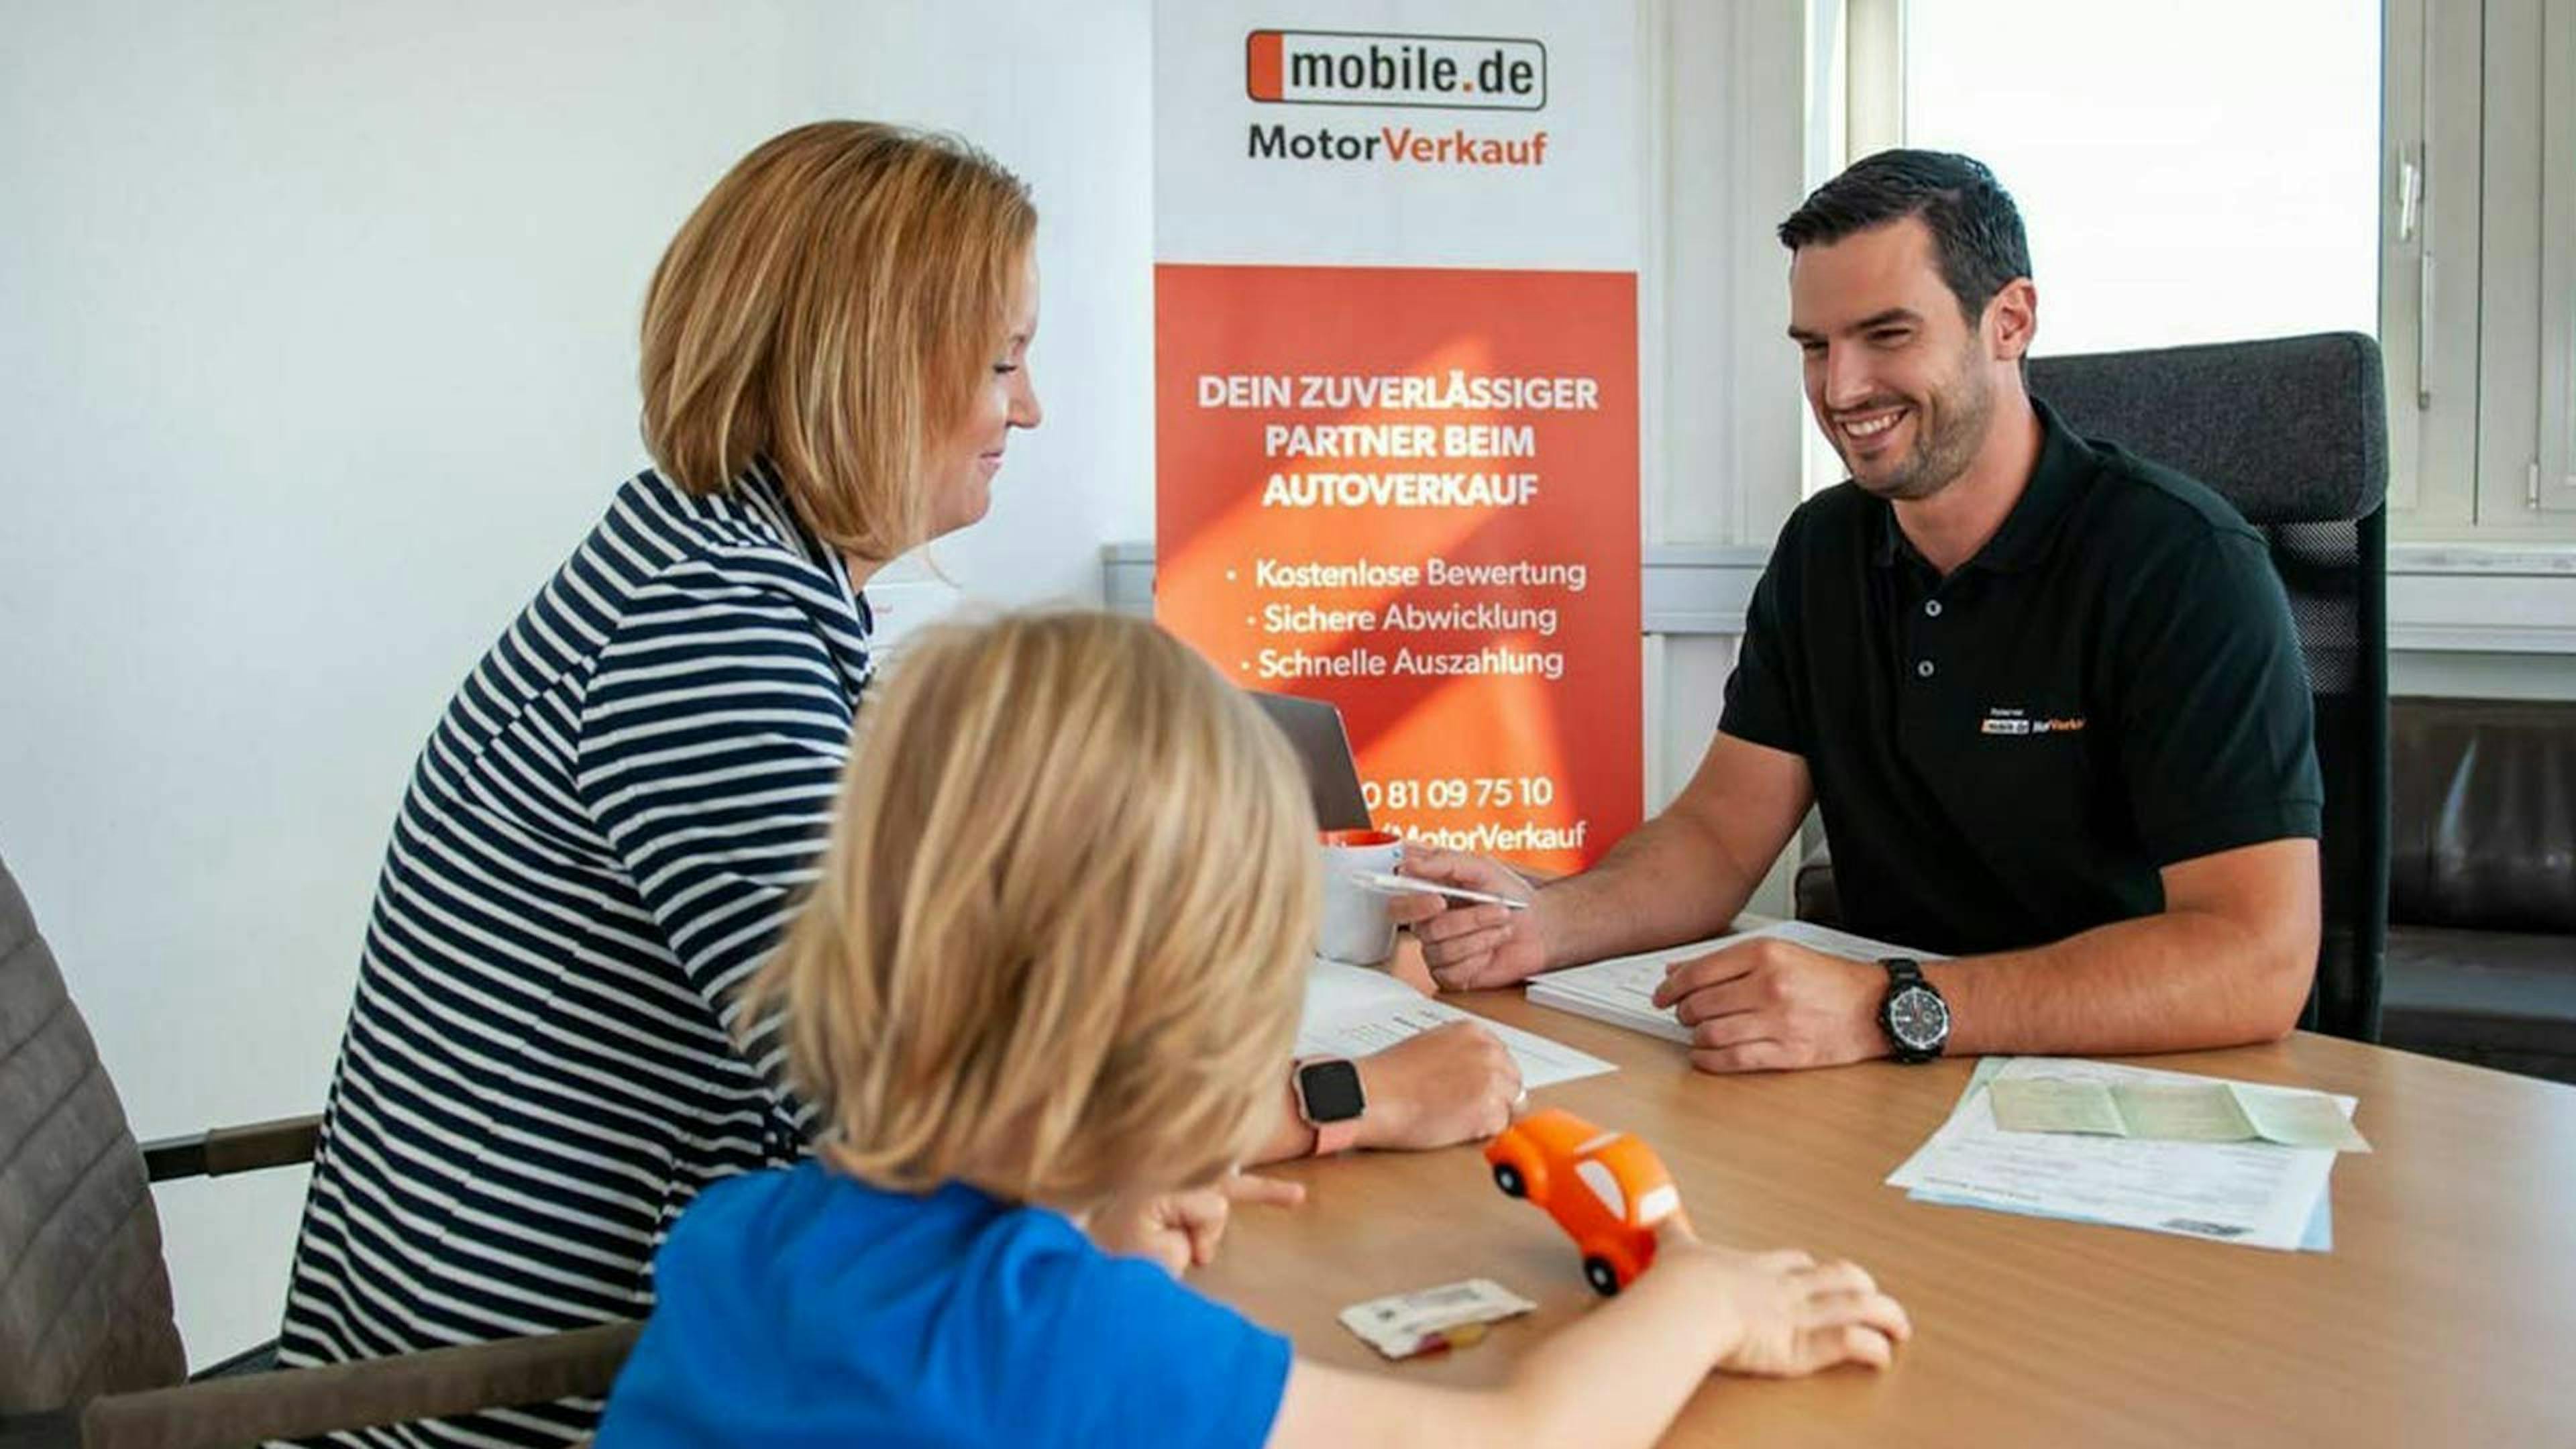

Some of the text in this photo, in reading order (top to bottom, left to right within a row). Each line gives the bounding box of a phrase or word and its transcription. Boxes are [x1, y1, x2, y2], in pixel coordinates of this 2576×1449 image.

[1291, 45, 1534, 95] mobile.de
[1248, 123, 1547, 166] MotorVerkauf
[1198, 370, 1599, 410] DEIN ZUVERLÄSSIGER
[1265, 425, 1535, 458] PARTNER BEIM
[1262, 473, 1539, 506] AUTOVERKAUF
[1256, 559, 1587, 591] Kostenlose Bewertung
[1264, 603, 1558, 635] Sichere Abwicklung
[1258, 649, 1564, 678] Schnelle Auszahlung
[1387, 780, 1420, 810] 81
[1426, 778, 1468, 809] 09
[1474, 777, 1514, 808] 75
[1517, 776, 1554, 807] 10
